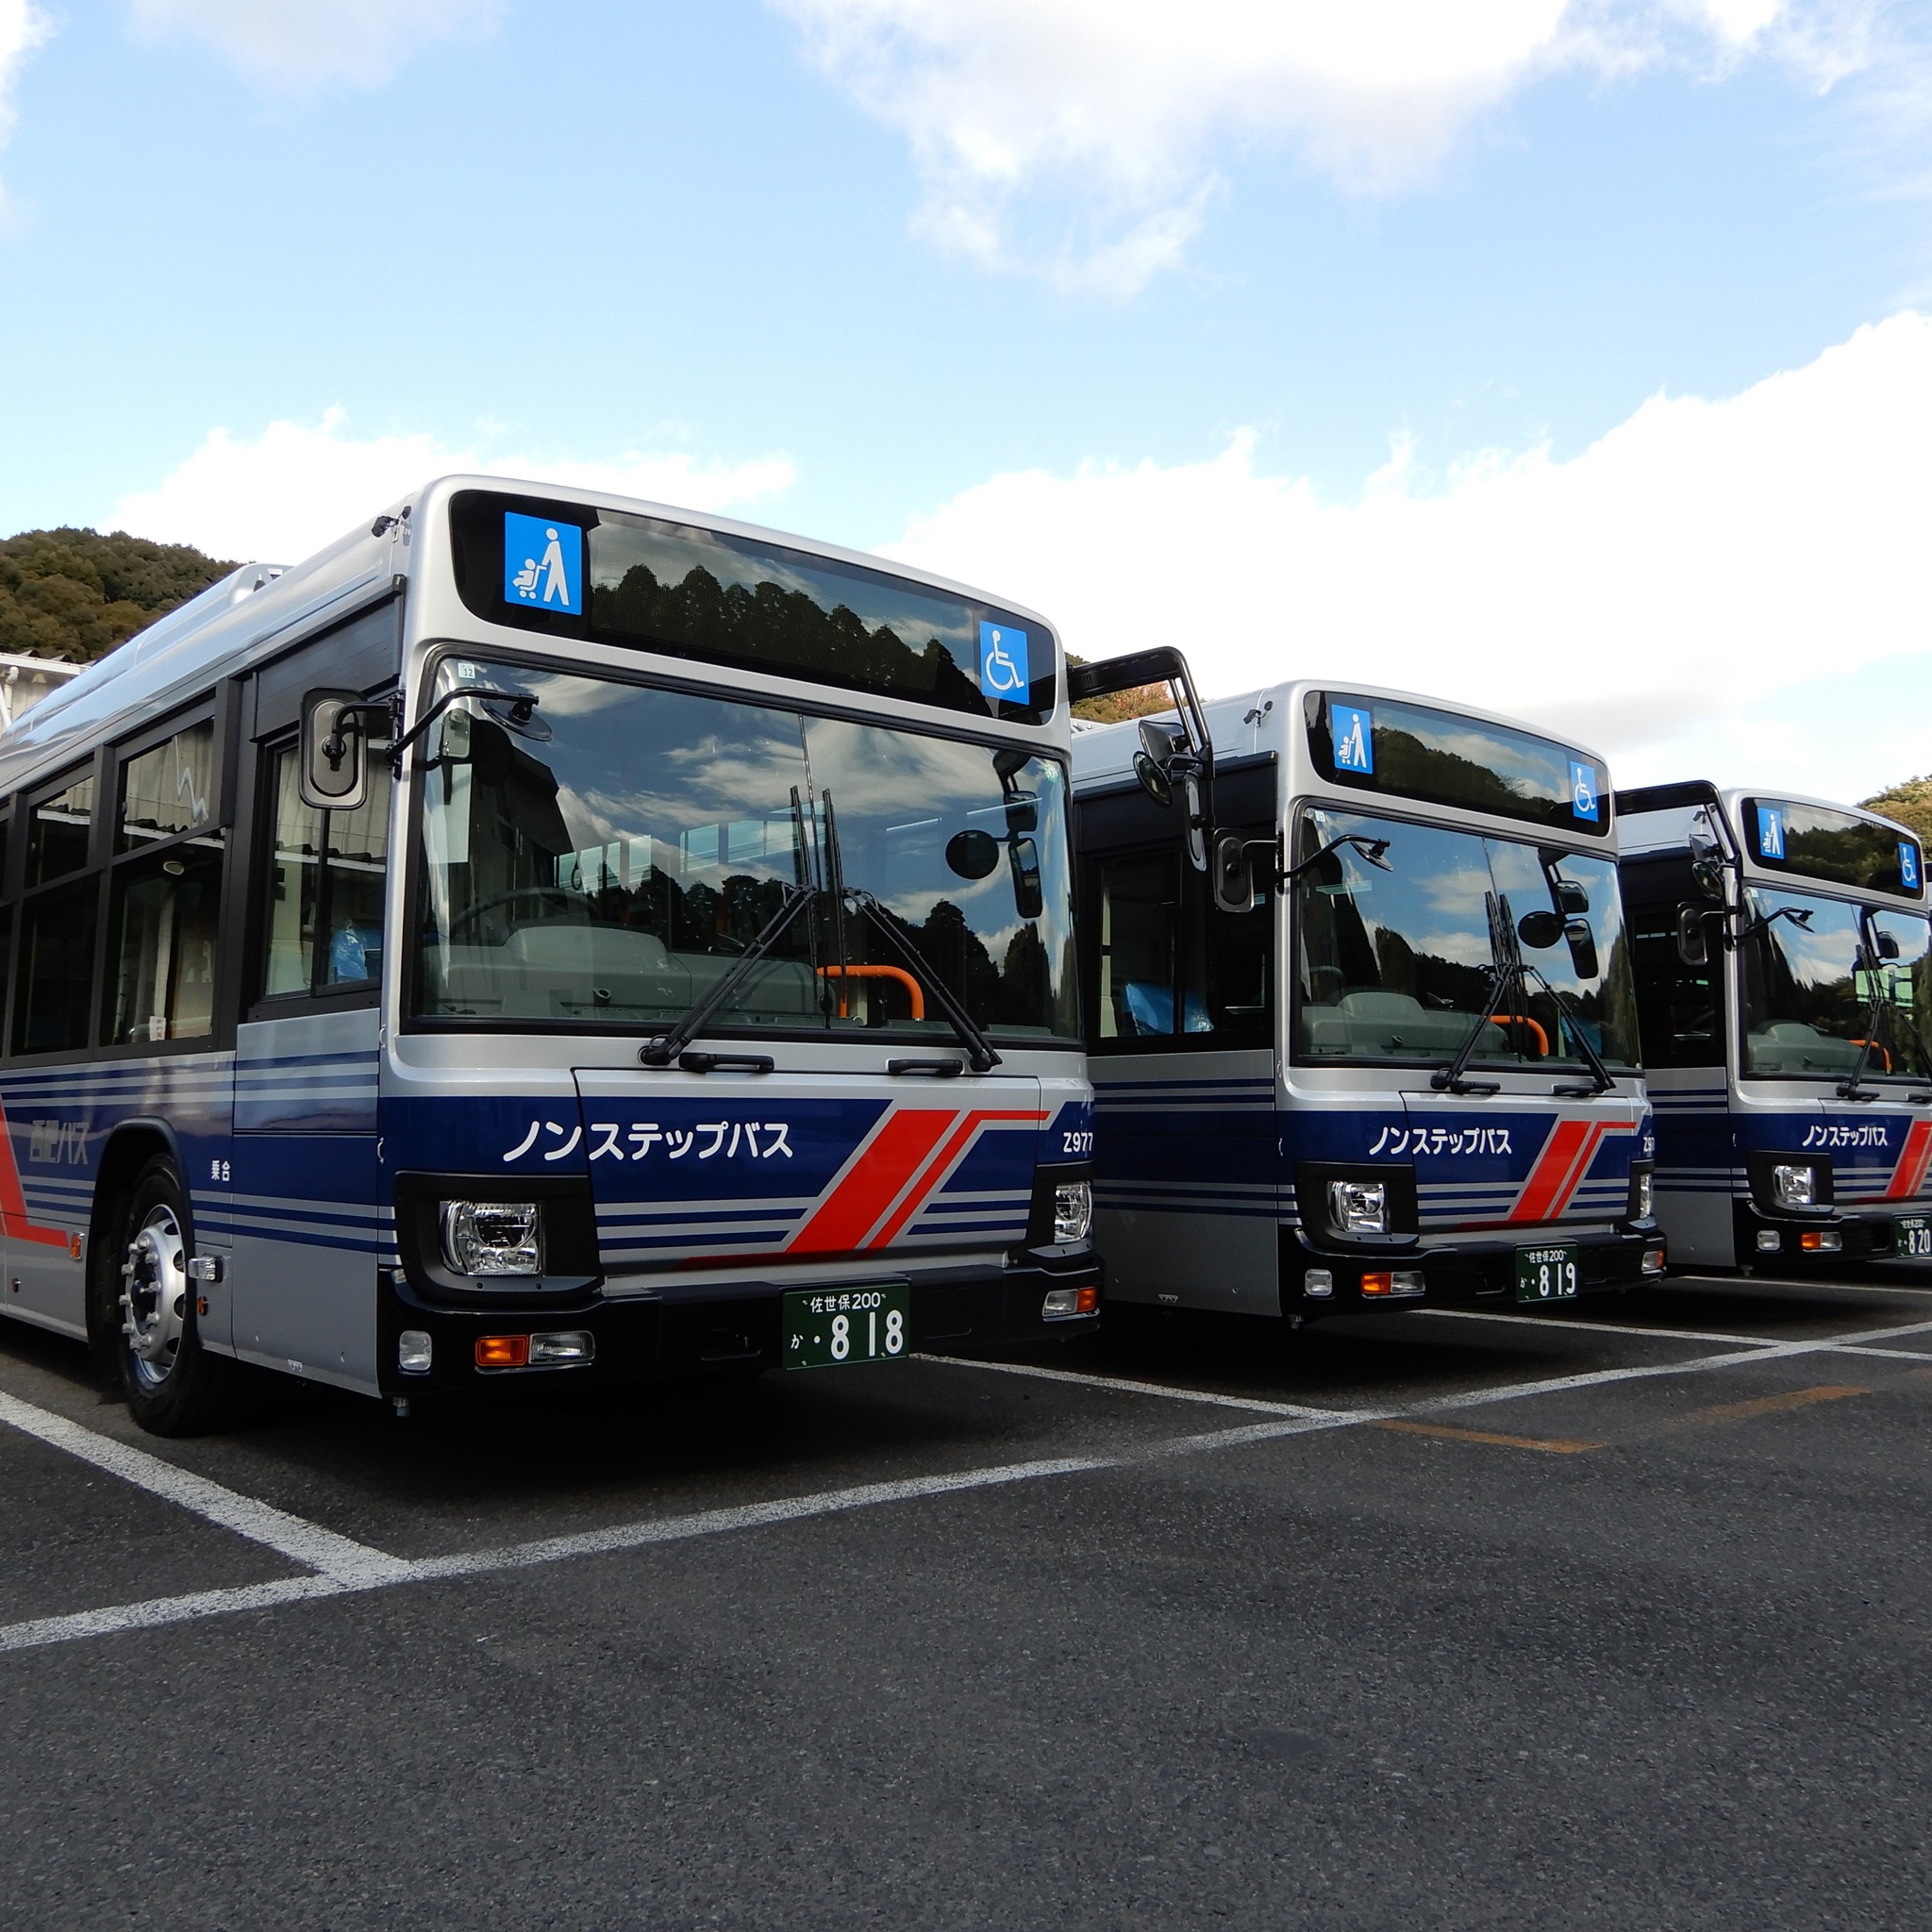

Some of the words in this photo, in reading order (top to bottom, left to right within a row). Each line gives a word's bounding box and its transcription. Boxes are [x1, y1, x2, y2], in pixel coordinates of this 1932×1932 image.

[503, 1121, 793, 1162] ノンステップバス
[1063, 1132, 1093, 1153] Z977
[1369, 1126, 1512, 1156] ノンステップバス
[1802, 1124, 1889, 1147] ノンステップバス
